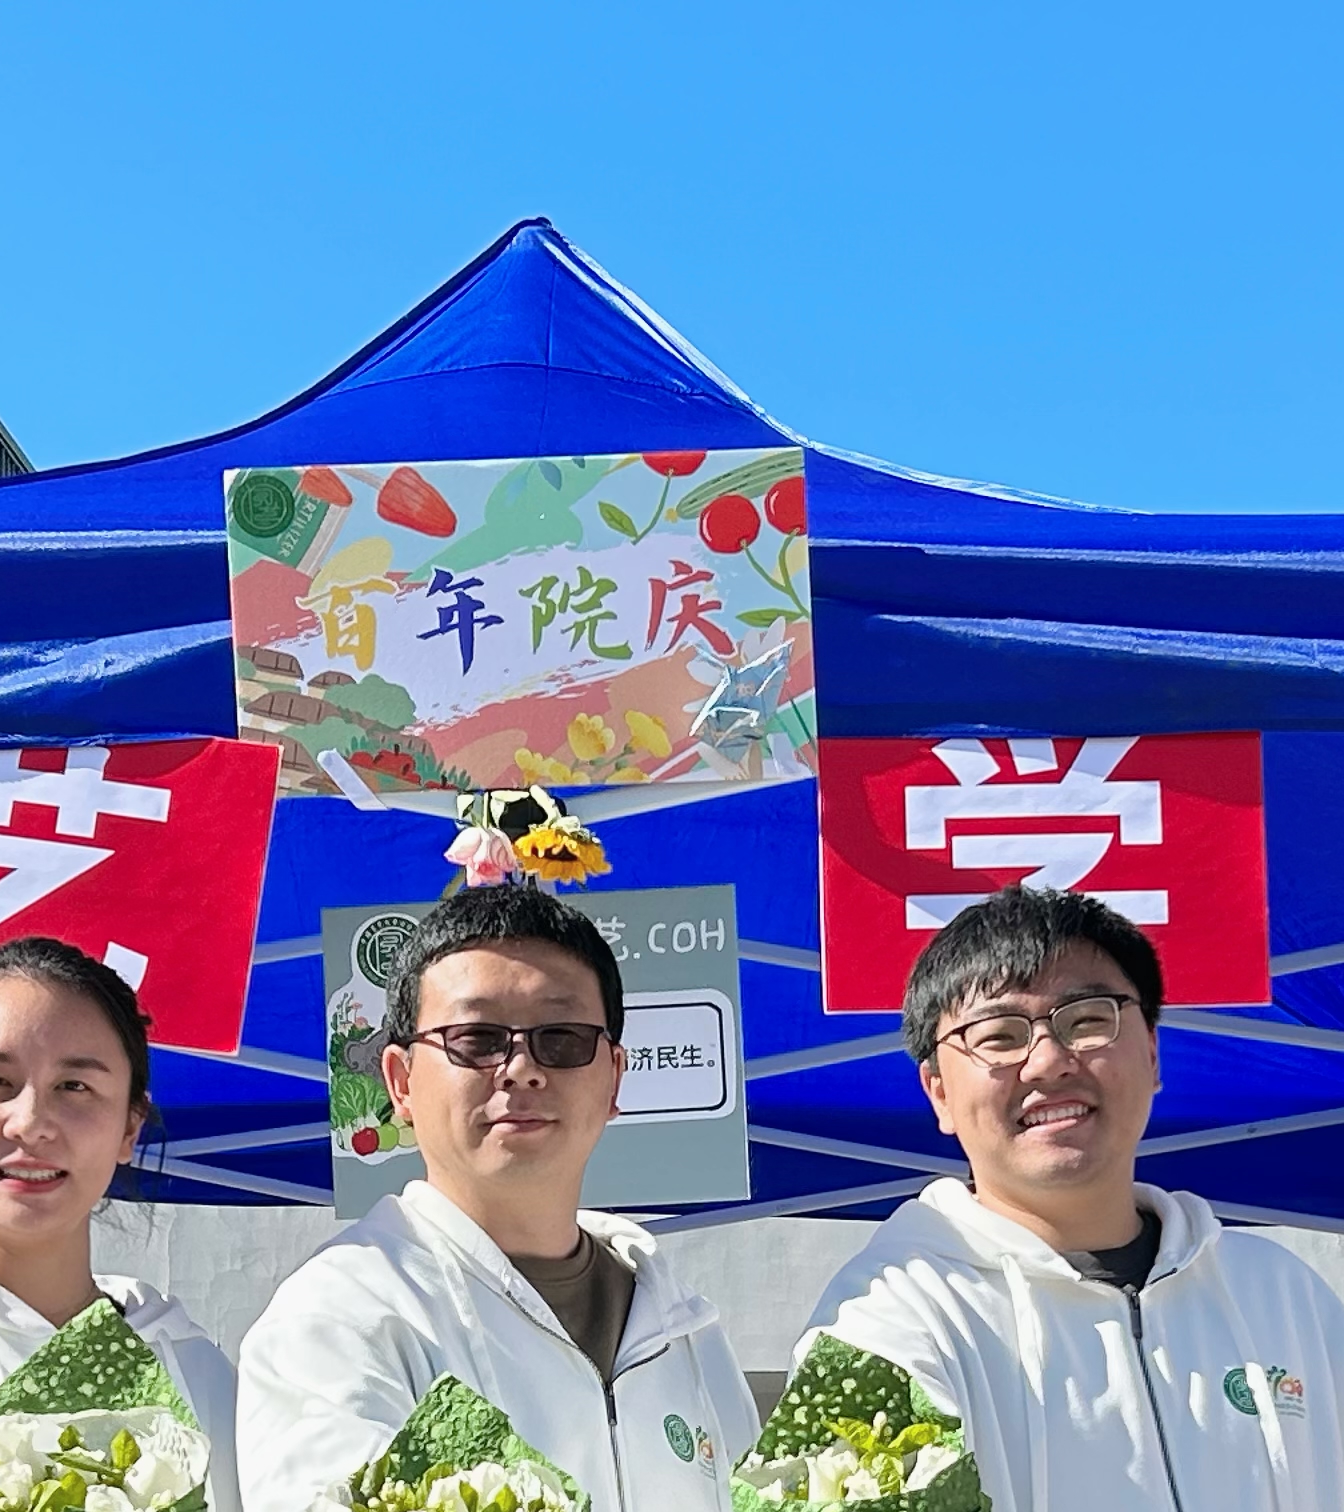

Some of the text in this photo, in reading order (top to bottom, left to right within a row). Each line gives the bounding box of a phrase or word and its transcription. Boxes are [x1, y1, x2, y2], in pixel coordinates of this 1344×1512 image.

[298, 560, 735, 676] 百年院庆
[904, 736, 1169, 931] 学
[625, 1043, 716, 1072] 济民生。
